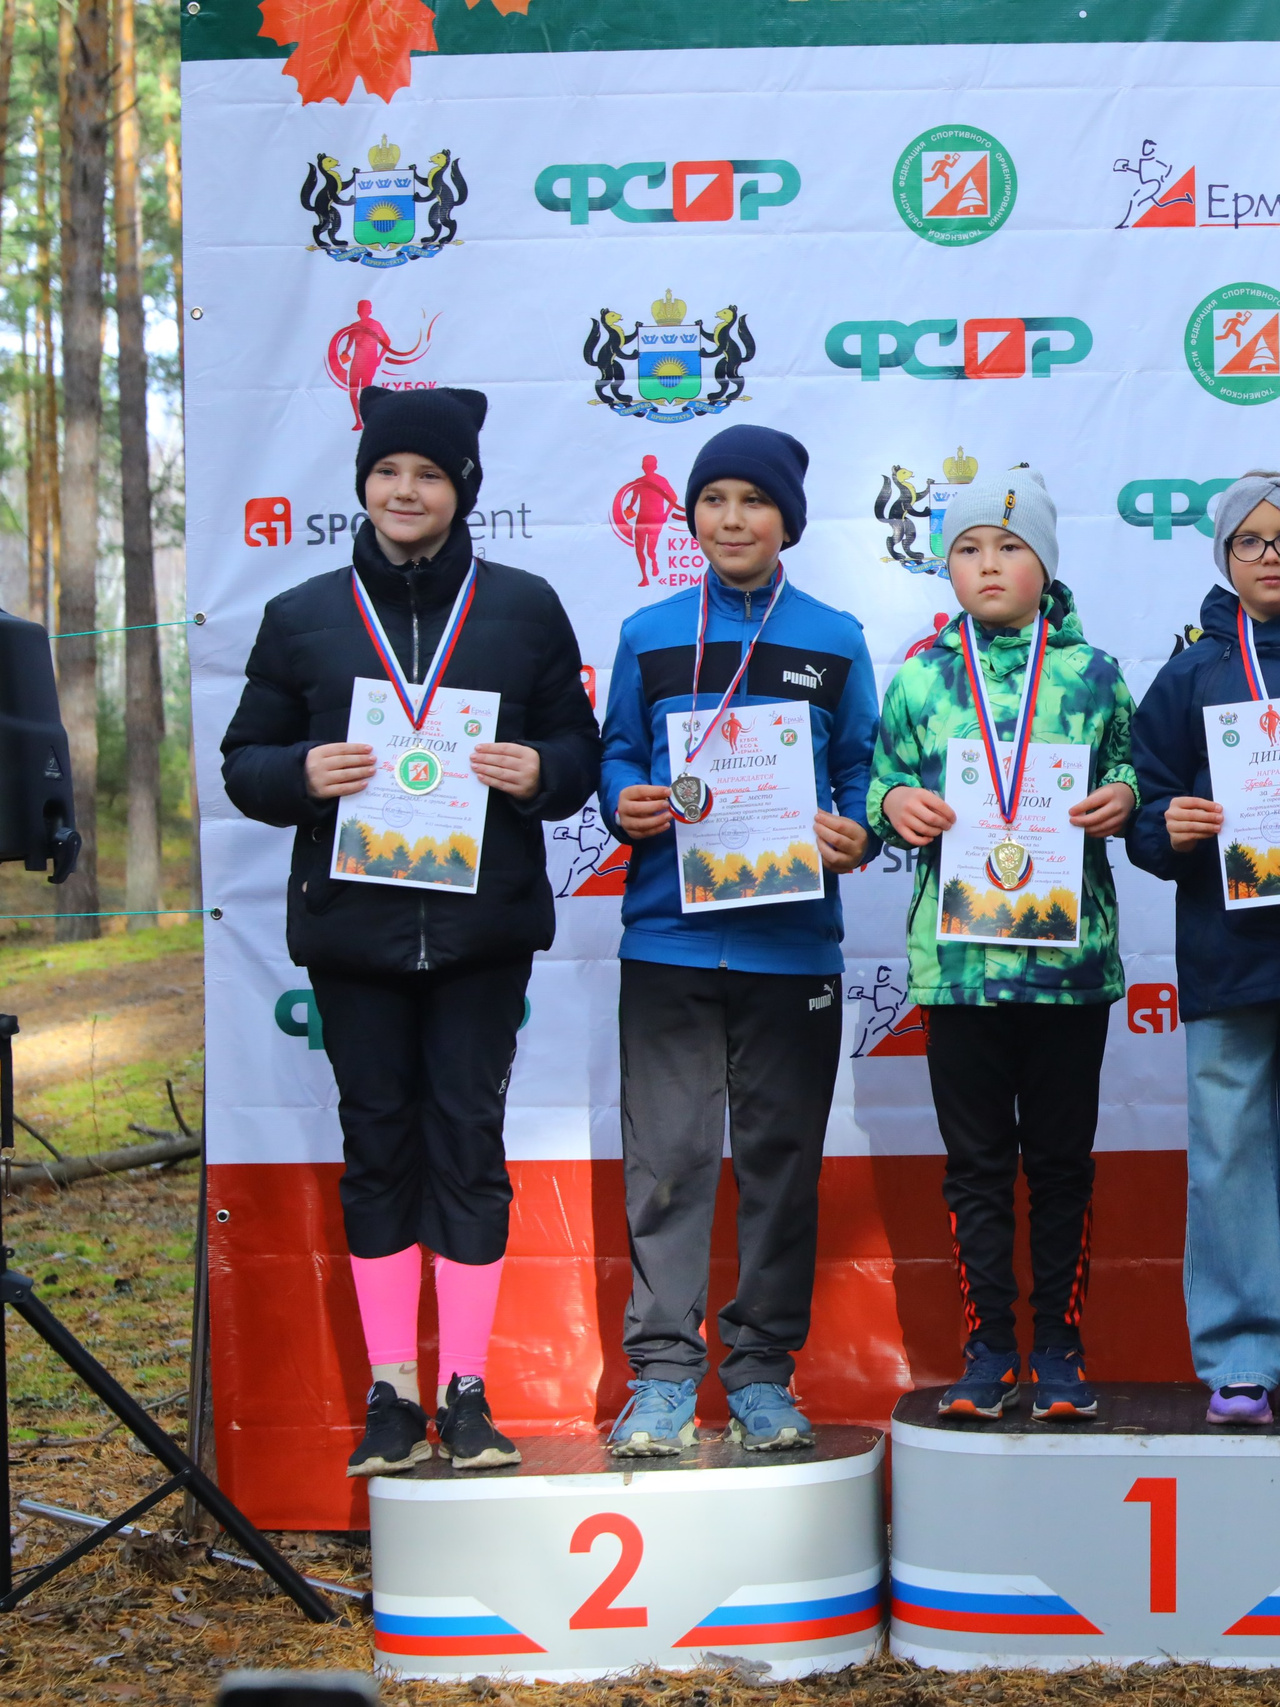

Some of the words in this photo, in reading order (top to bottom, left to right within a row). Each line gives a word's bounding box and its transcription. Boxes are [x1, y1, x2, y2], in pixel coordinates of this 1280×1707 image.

[931, 131, 992, 148] СПОРТИВНОГО
[899, 141, 926, 187] ФЕДЕРАЦИЯ
[988, 152, 1012, 227] ОРИЕНТИРОВАНИЯ
[899, 192, 923, 228] ОБЛАСТИ
[928, 229, 982, 241] ТЮМЕНСКОЙ
[1190, 299, 1218, 346] ФЕДЕРАЦИЯ
[1191, 350, 1215, 386] ОБЛАСТИ
[1220, 386, 1275, 400] ТЮМЕНСКОЙ
[668, 538, 700, 551] КУБ
[668, 555, 704, 568] КСО
[783, 670, 817, 689] PUMA
[471, 707, 491, 716] Ермак
[784, 715, 805, 724] Ермак
[710, 754, 778, 773] ДИПЛОМ
[1063, 761, 1083, 769] Ермак
[717, 773, 774, 785] НАГРАЖДАЕТСЯ
[809, 994, 831, 1011] PUMA
[1123, 1477, 1178, 1613] 1
[568, 1513, 649, 1630] 2
